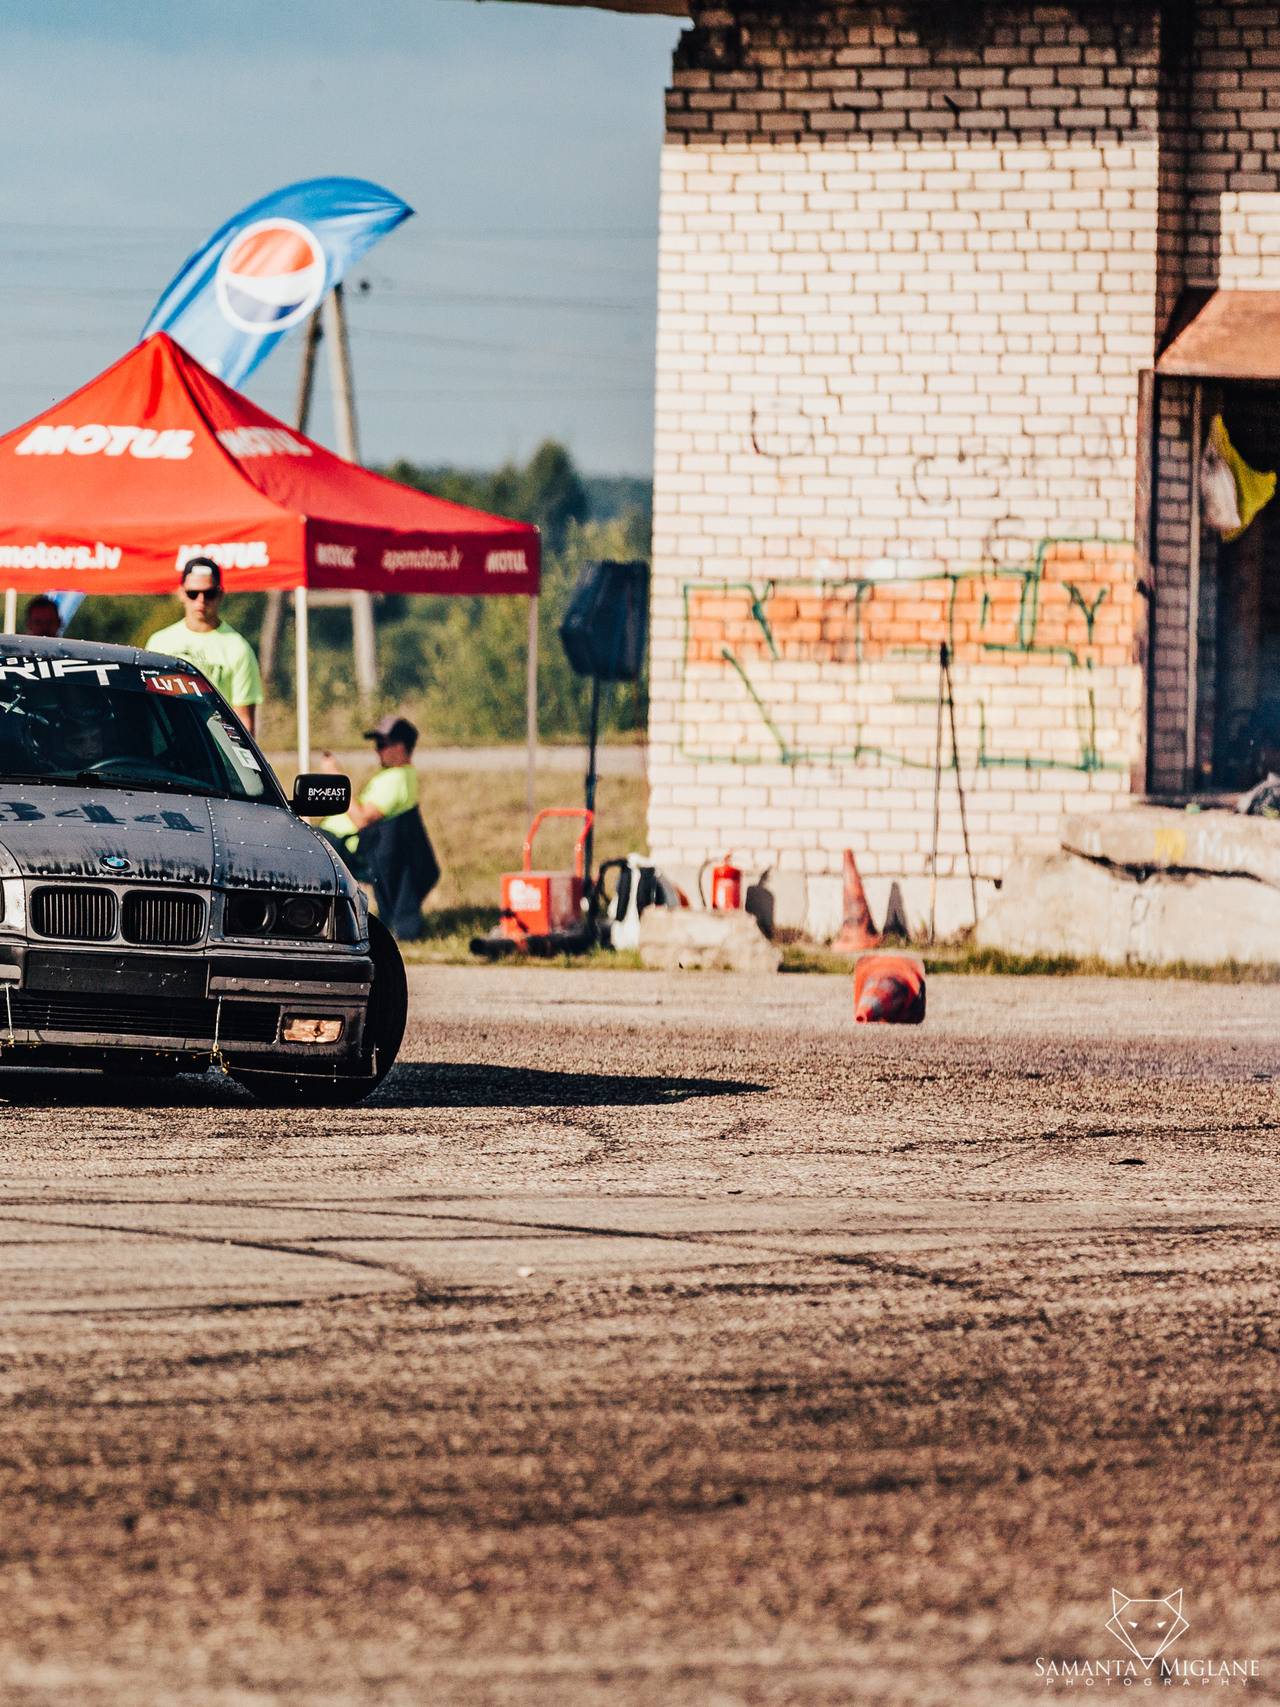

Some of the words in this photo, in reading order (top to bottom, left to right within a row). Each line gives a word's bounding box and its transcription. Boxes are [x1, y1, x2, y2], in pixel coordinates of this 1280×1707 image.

[14, 424, 194, 459] MOTUL
[216, 426, 313, 457] MOTUL
[484, 550, 528, 573] MOTUL
